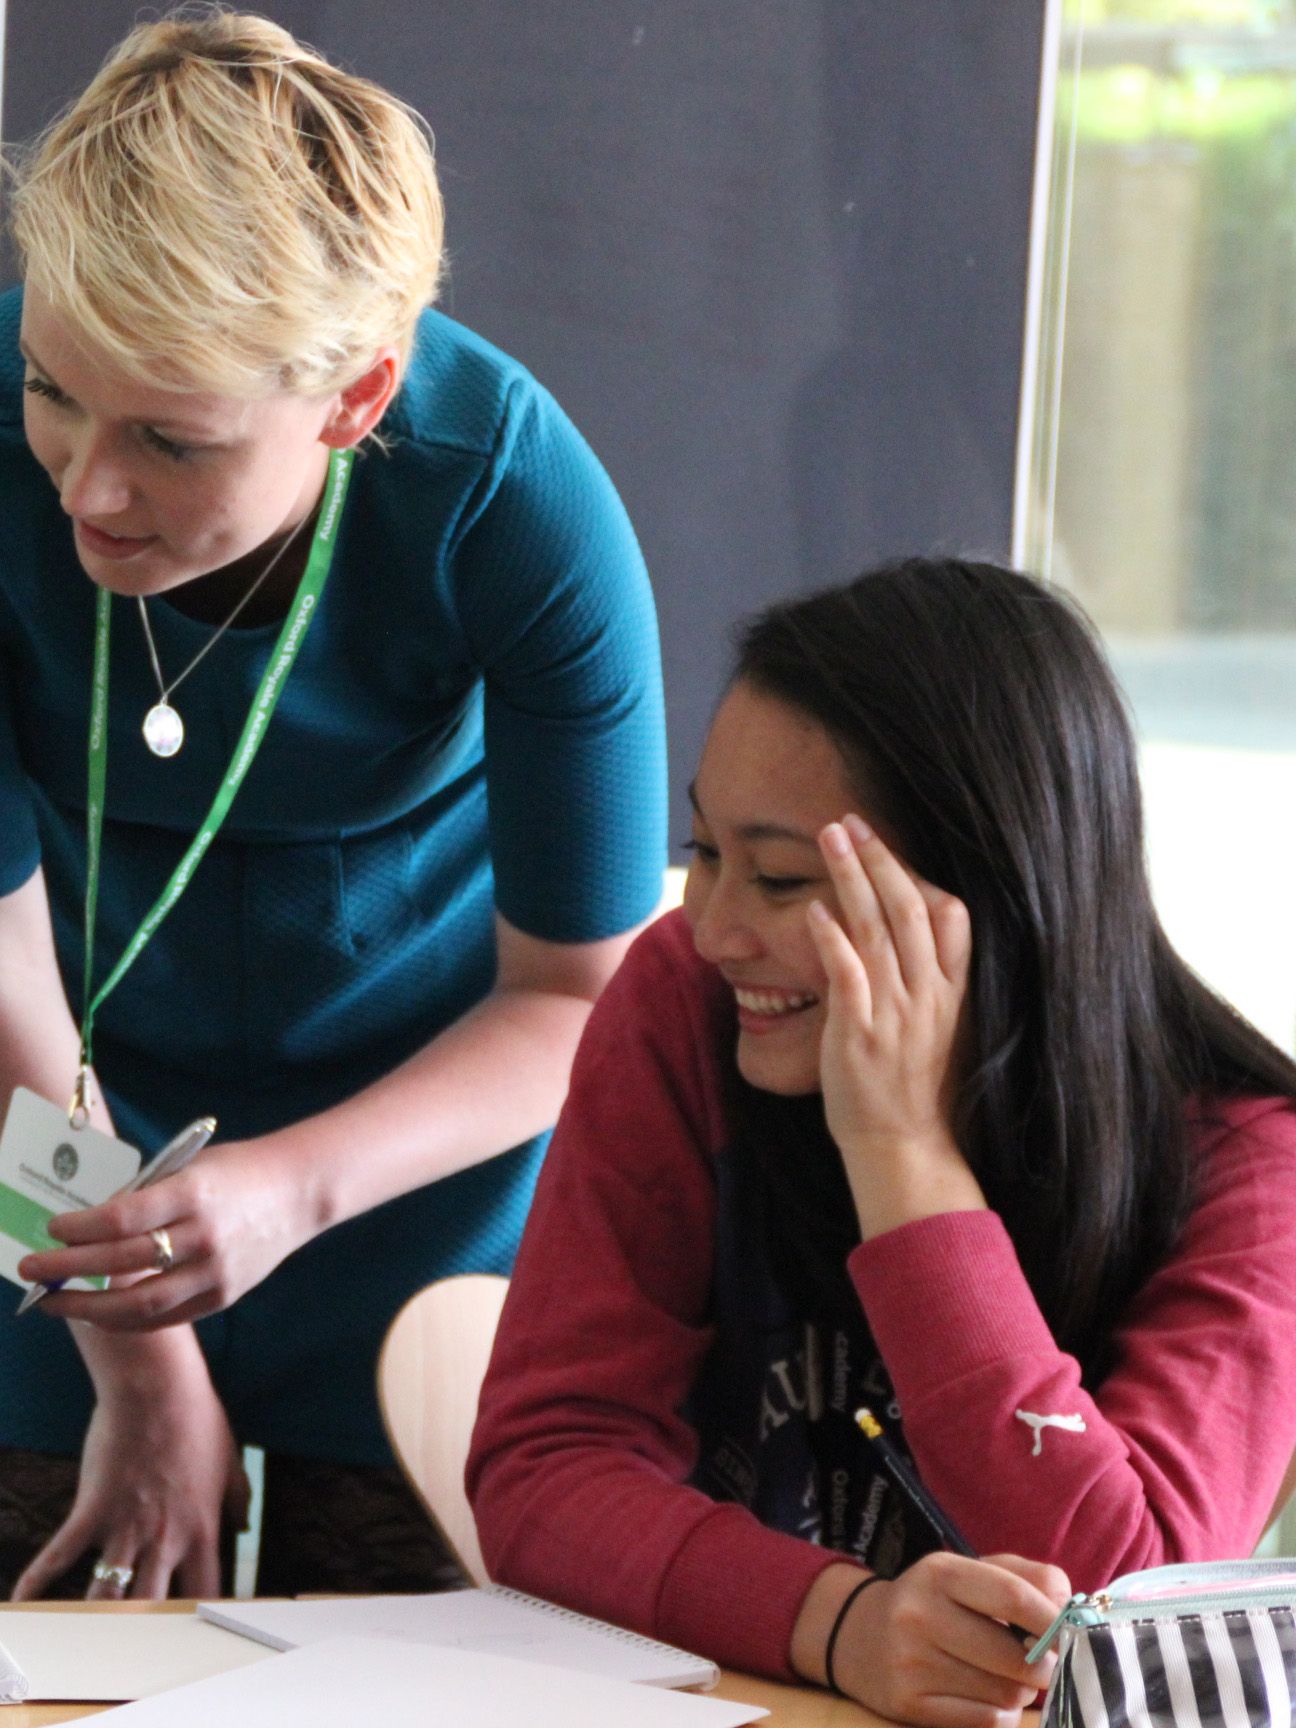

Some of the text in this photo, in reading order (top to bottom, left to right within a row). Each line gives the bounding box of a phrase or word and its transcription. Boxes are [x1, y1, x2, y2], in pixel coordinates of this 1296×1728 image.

[319, 458, 349, 541] Academy
[227, 594, 315, 786] Oxford Royale Academy
